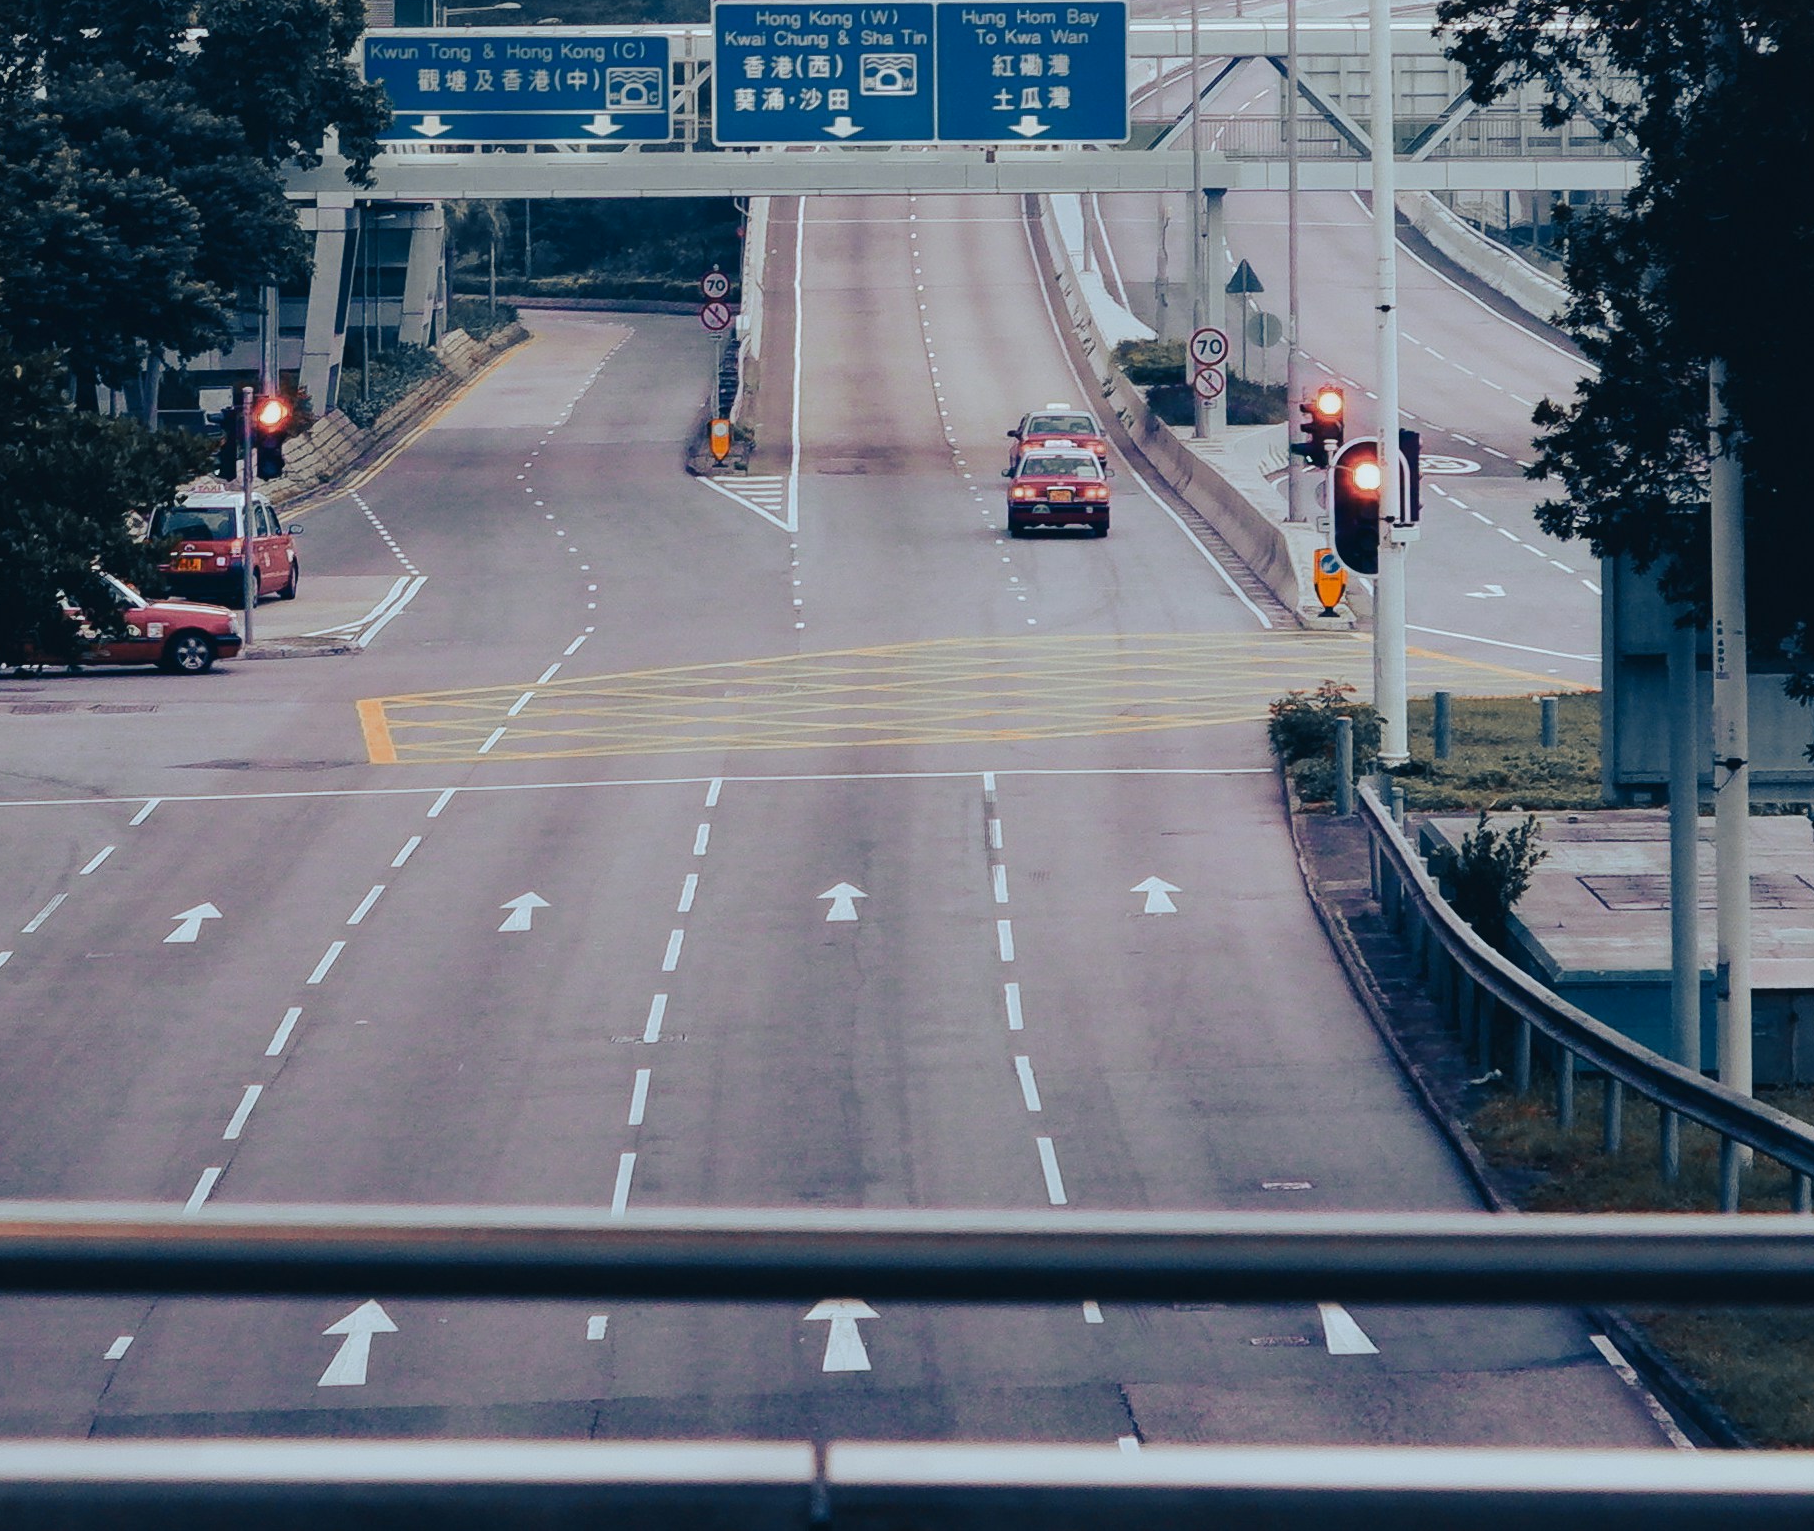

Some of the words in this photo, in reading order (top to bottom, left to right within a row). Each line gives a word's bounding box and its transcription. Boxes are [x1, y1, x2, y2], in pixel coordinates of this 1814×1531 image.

[756, 11, 801, 28] Hong
[809, 10, 853, 28] Kong
[860, 9, 898, 26] (W)
[961, 9, 1006, 28] Hung
[1017, 9, 1056, 24] Hom
[1066, 8, 1099, 27] Bay
[724, 31, 766, 46] Kwai
[774, 30, 829, 49] Chung
[837, 30, 851, 45] &
[860, 29, 894, 45] Sha
[900, 29, 928, 45] Tin
[975, 29, 997, 45] To
[1005, 28, 1042, 45] Kwa
[1051, 29, 1089, 44] Wan
[370, 43, 418, 60] Kwun
[428, 43, 471, 62] Tong
[483, 43, 496, 59] &
[506, 43, 553, 62] Hong
[560, 42, 605, 62] Kong
[613, 42, 645, 59] (C)
[742, 54, 844, 79] 香港(西)
[992, 53, 1071, 77] 紅磡灣
[992, 86, 1071, 110] 土瓜灣
[707, 279, 726, 292] 70
[1196, 339, 1223, 356] 70
